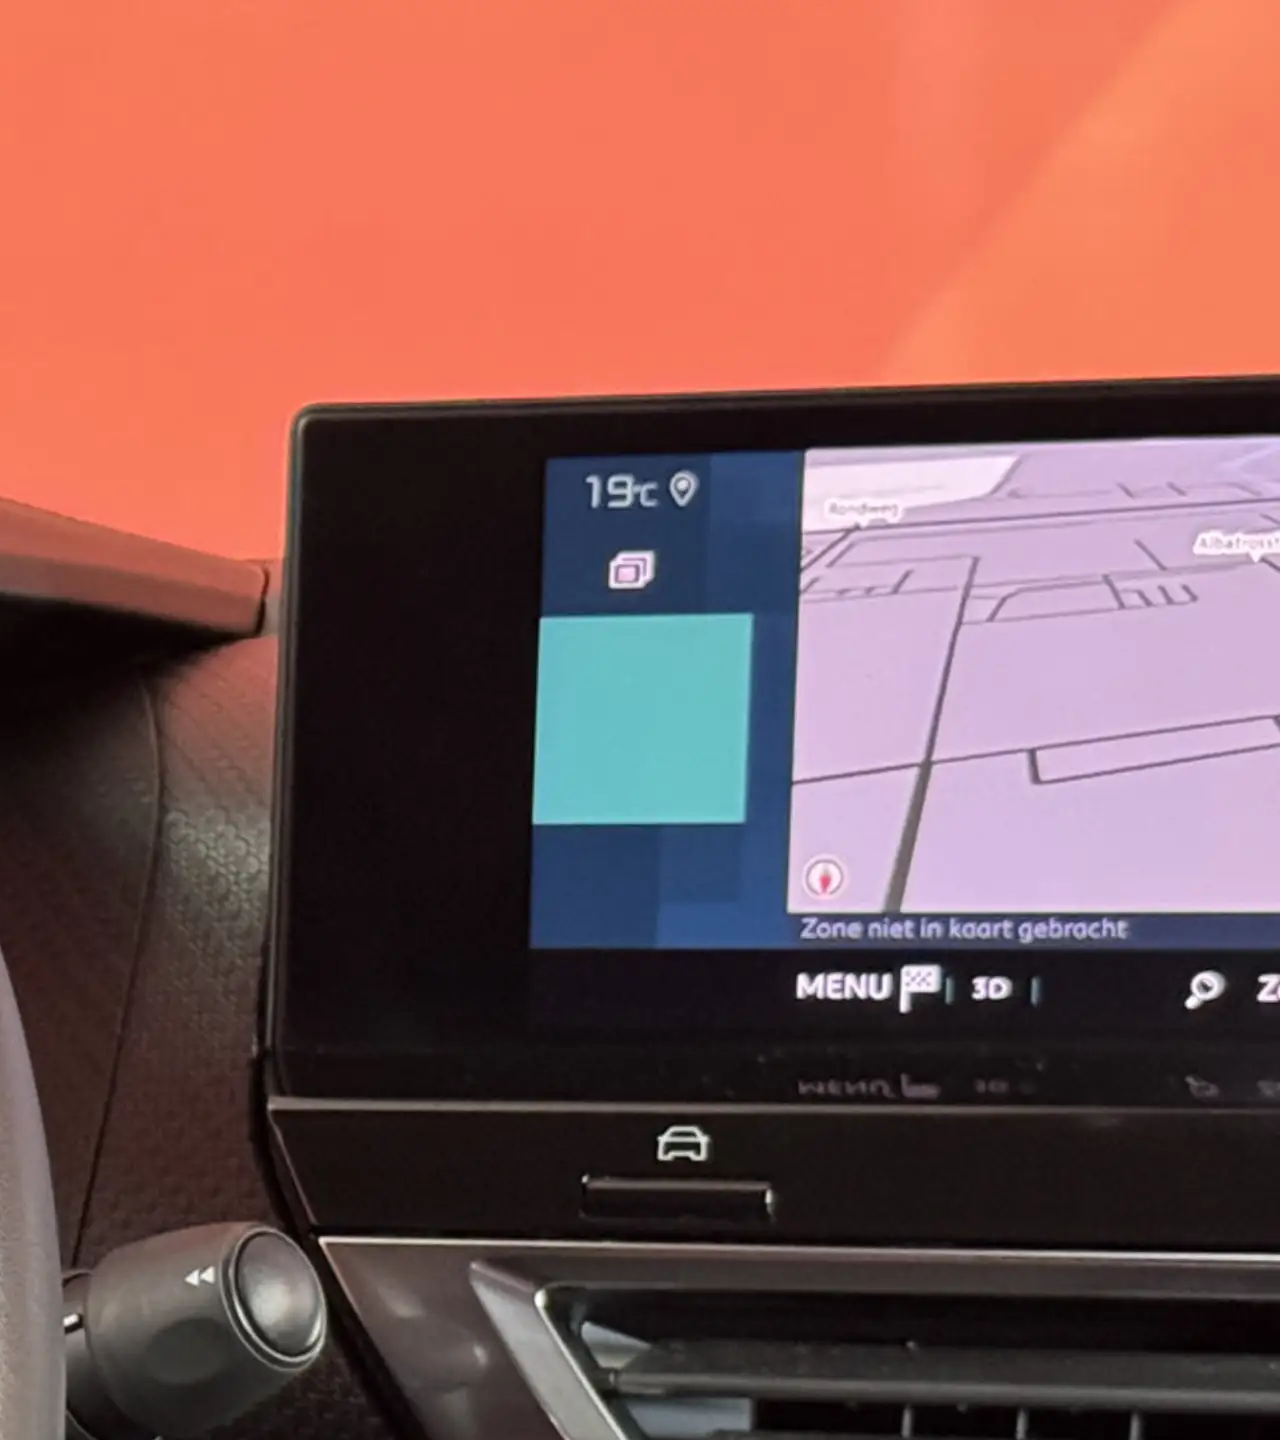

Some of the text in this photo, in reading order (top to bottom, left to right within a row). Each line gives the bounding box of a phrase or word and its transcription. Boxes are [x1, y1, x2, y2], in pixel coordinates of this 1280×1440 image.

[800, 917, 1131, 944] Zone niet in kaart gebracht
[795, 971, 893, 1001] MENU
[970, 976, 1014, 1001] 3D
